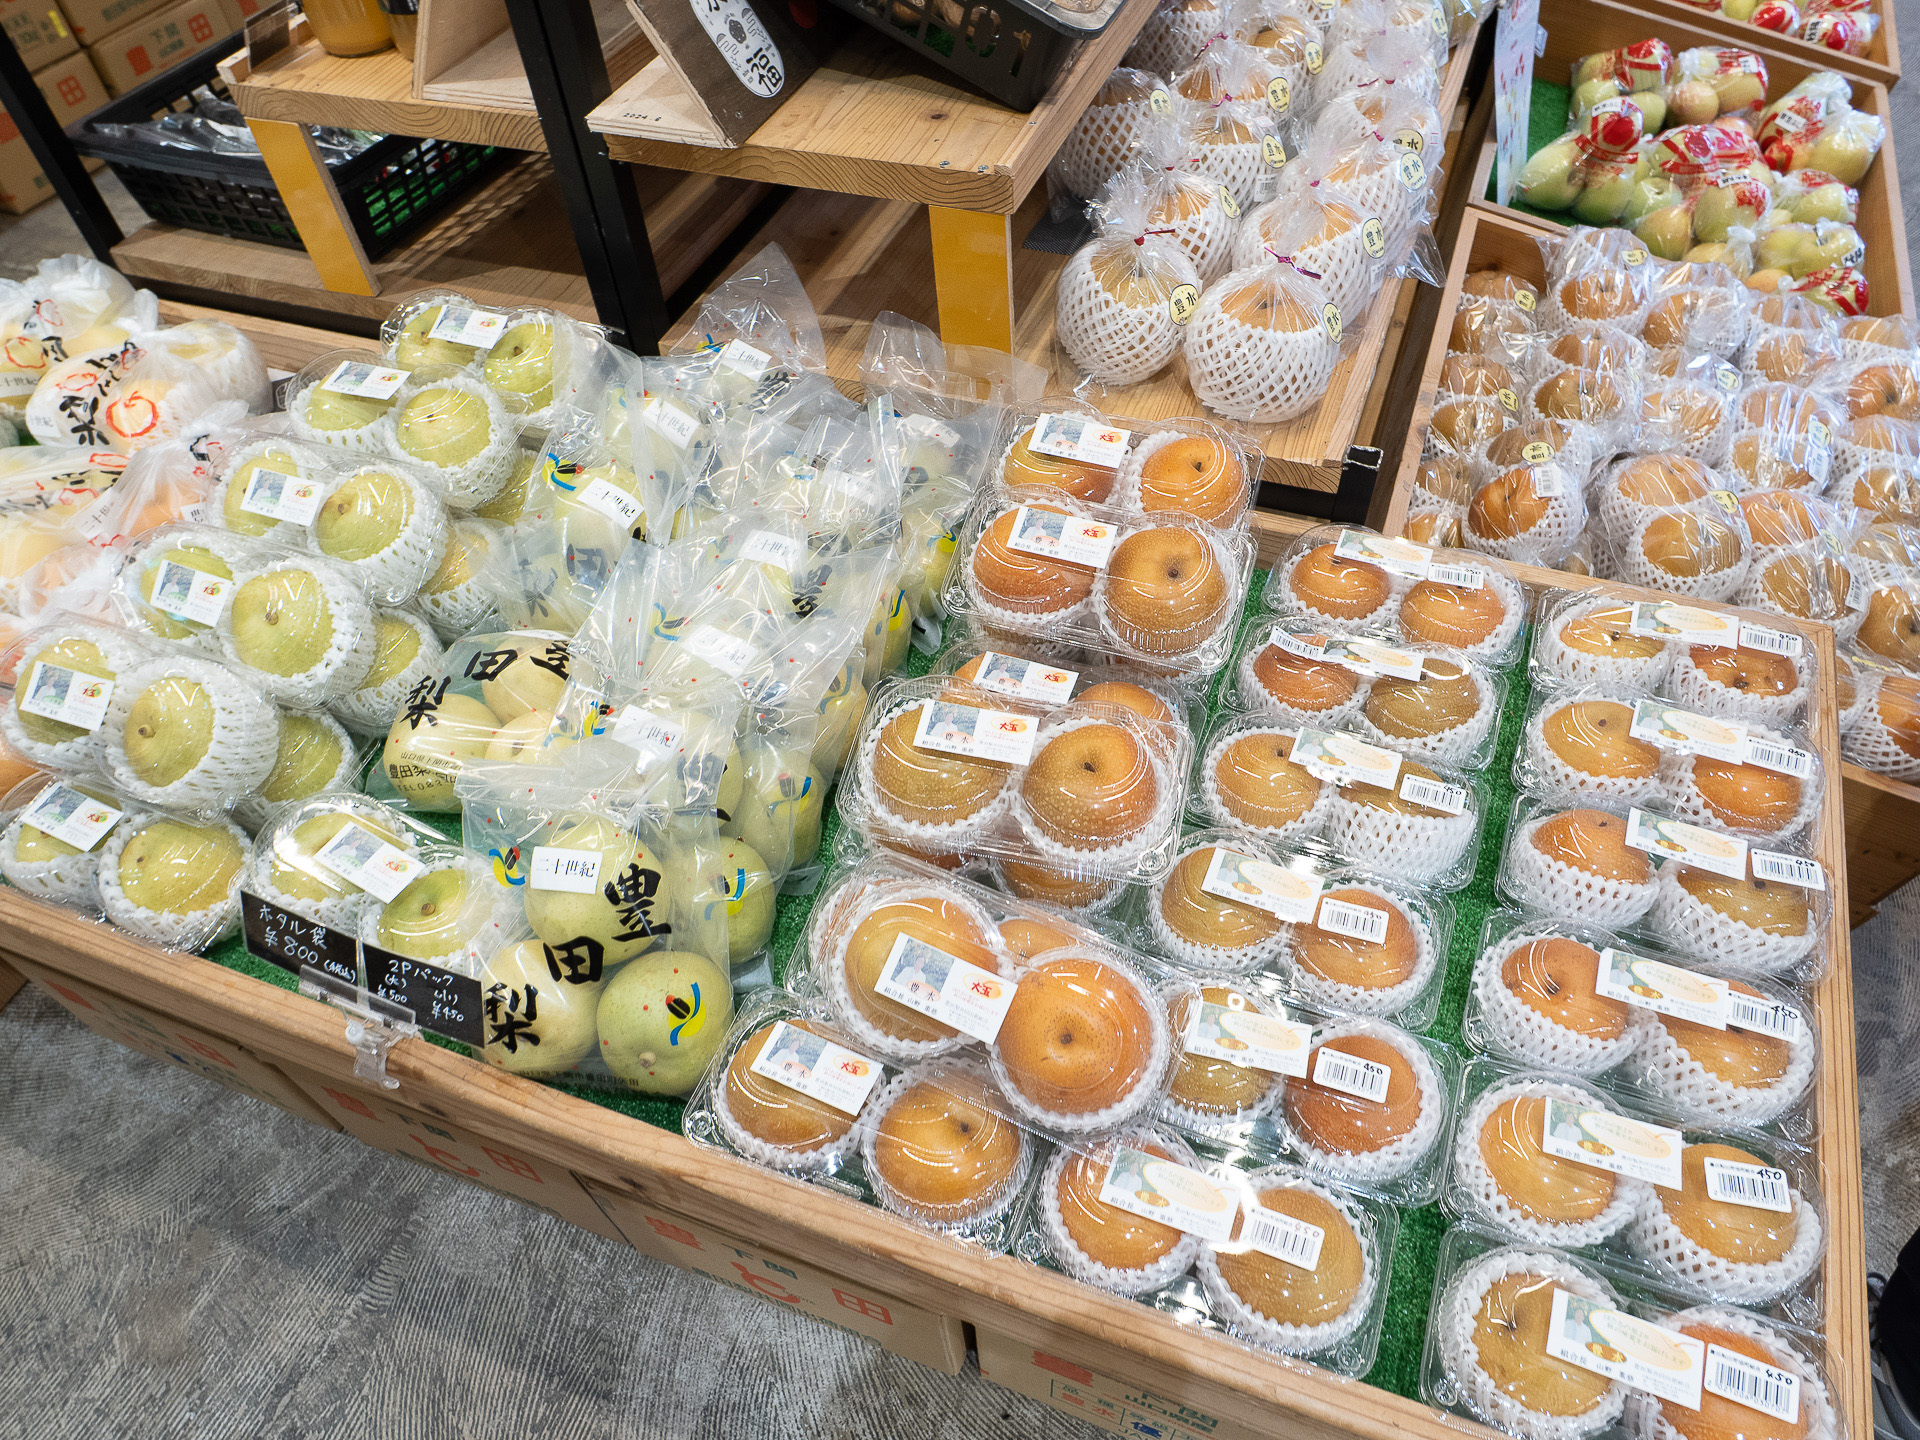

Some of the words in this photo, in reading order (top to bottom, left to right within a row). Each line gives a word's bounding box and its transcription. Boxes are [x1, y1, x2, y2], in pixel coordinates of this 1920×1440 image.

[1404, 159, 1421, 181] 豊水
[1366, 226, 1383, 248] 豊水
[1174, 292, 1197, 316] 豊水
[650, 409, 691, 436] 二十世紀
[1098, 433, 1114, 442] 大玉
[594, 486, 636, 518] 二十世紀
[1082, 528, 1099, 538] 大玉
[1043, 673, 1060, 682] 大玉
[999, 721, 1018, 732] 大玉
[1444, 785, 1462, 796] 450
[535, 858, 596, 878] 二十世紀
[260, 904, 327, 949] ホタル袋
[484, 862, 672, 1054] 豊田梨
[388, 960, 453, 986] 2Pパック
[970, 980, 992, 998] 大玉
[1771, 1005, 1798, 1020] 450
[839, 1060, 860, 1075] 大玉
[1364, 1062, 1383, 1076] 450
[1757, 1168, 1782, 1181] 450
[721, 1243, 798, 1280] 下関
[831, 1288, 894, 1326] 田
[1766, 1369, 1793, 1385] 450
